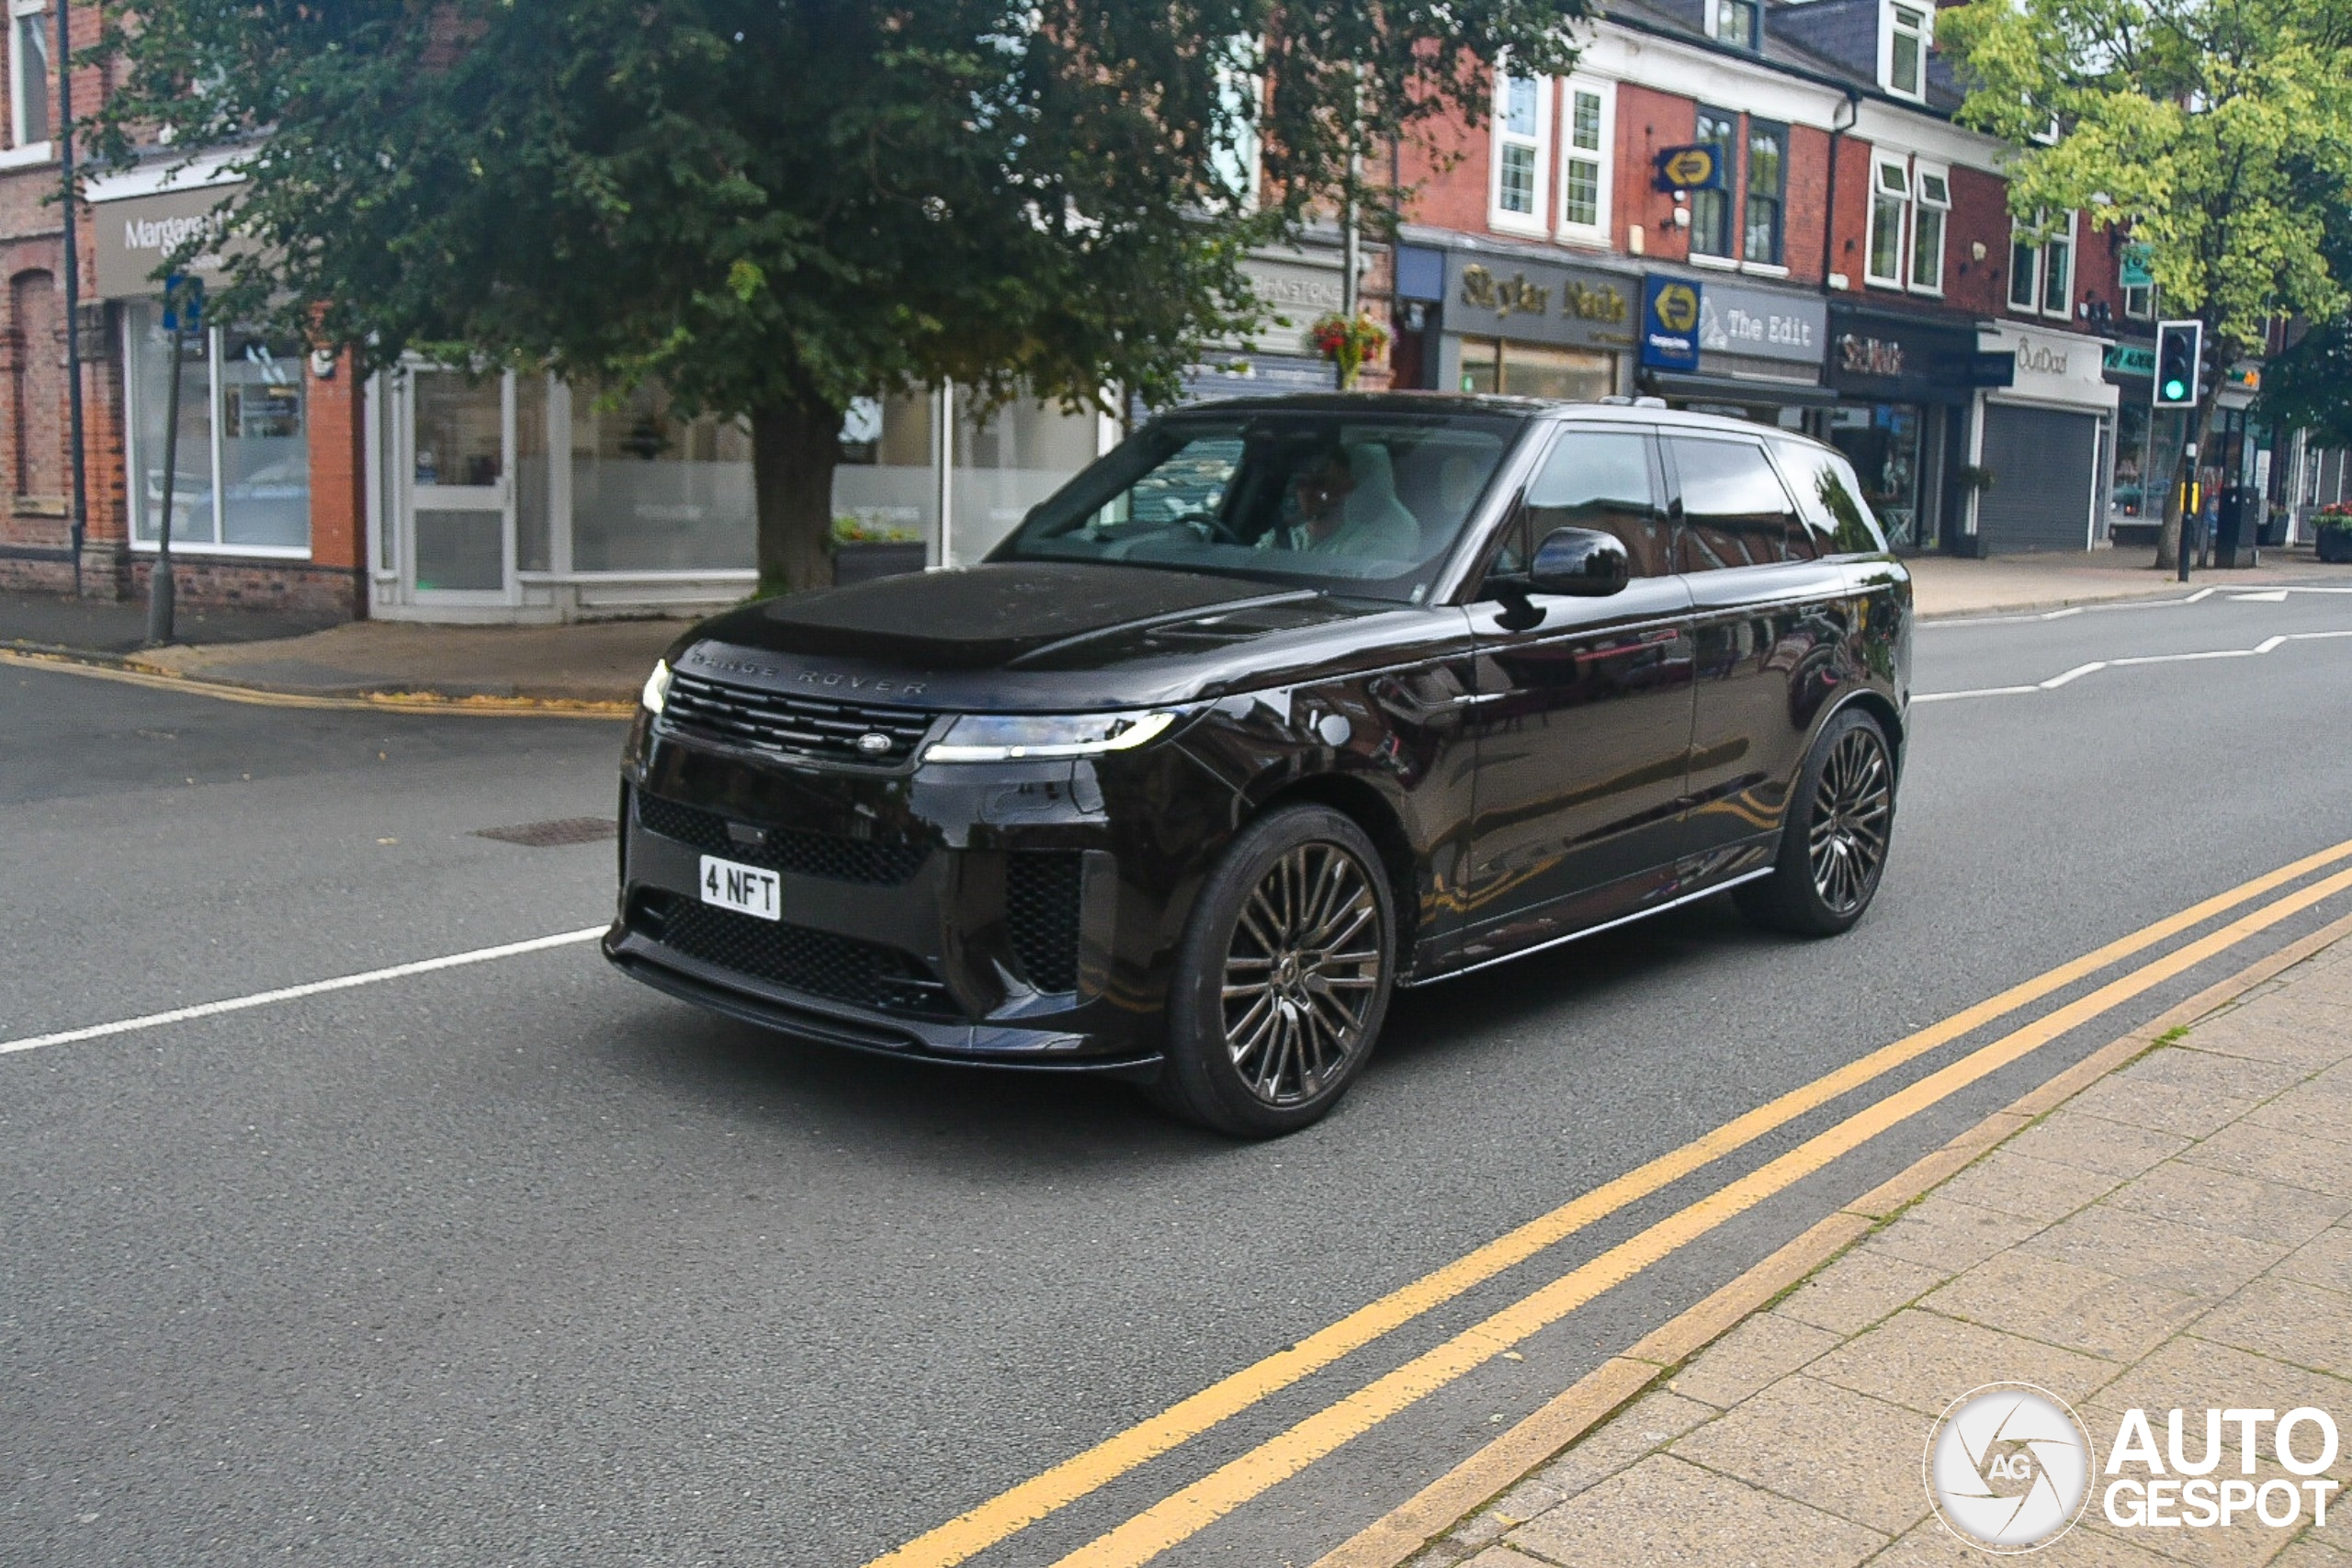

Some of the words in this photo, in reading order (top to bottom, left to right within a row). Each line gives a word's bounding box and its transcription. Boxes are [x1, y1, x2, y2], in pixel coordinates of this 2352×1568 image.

[1728, 309, 1763, 342] The
[1768, 315, 1812, 347] Edit
[798, 670, 927, 694] ROVER
[707, 863, 719, 897] 4
[727, 867, 775, 911] NFT
